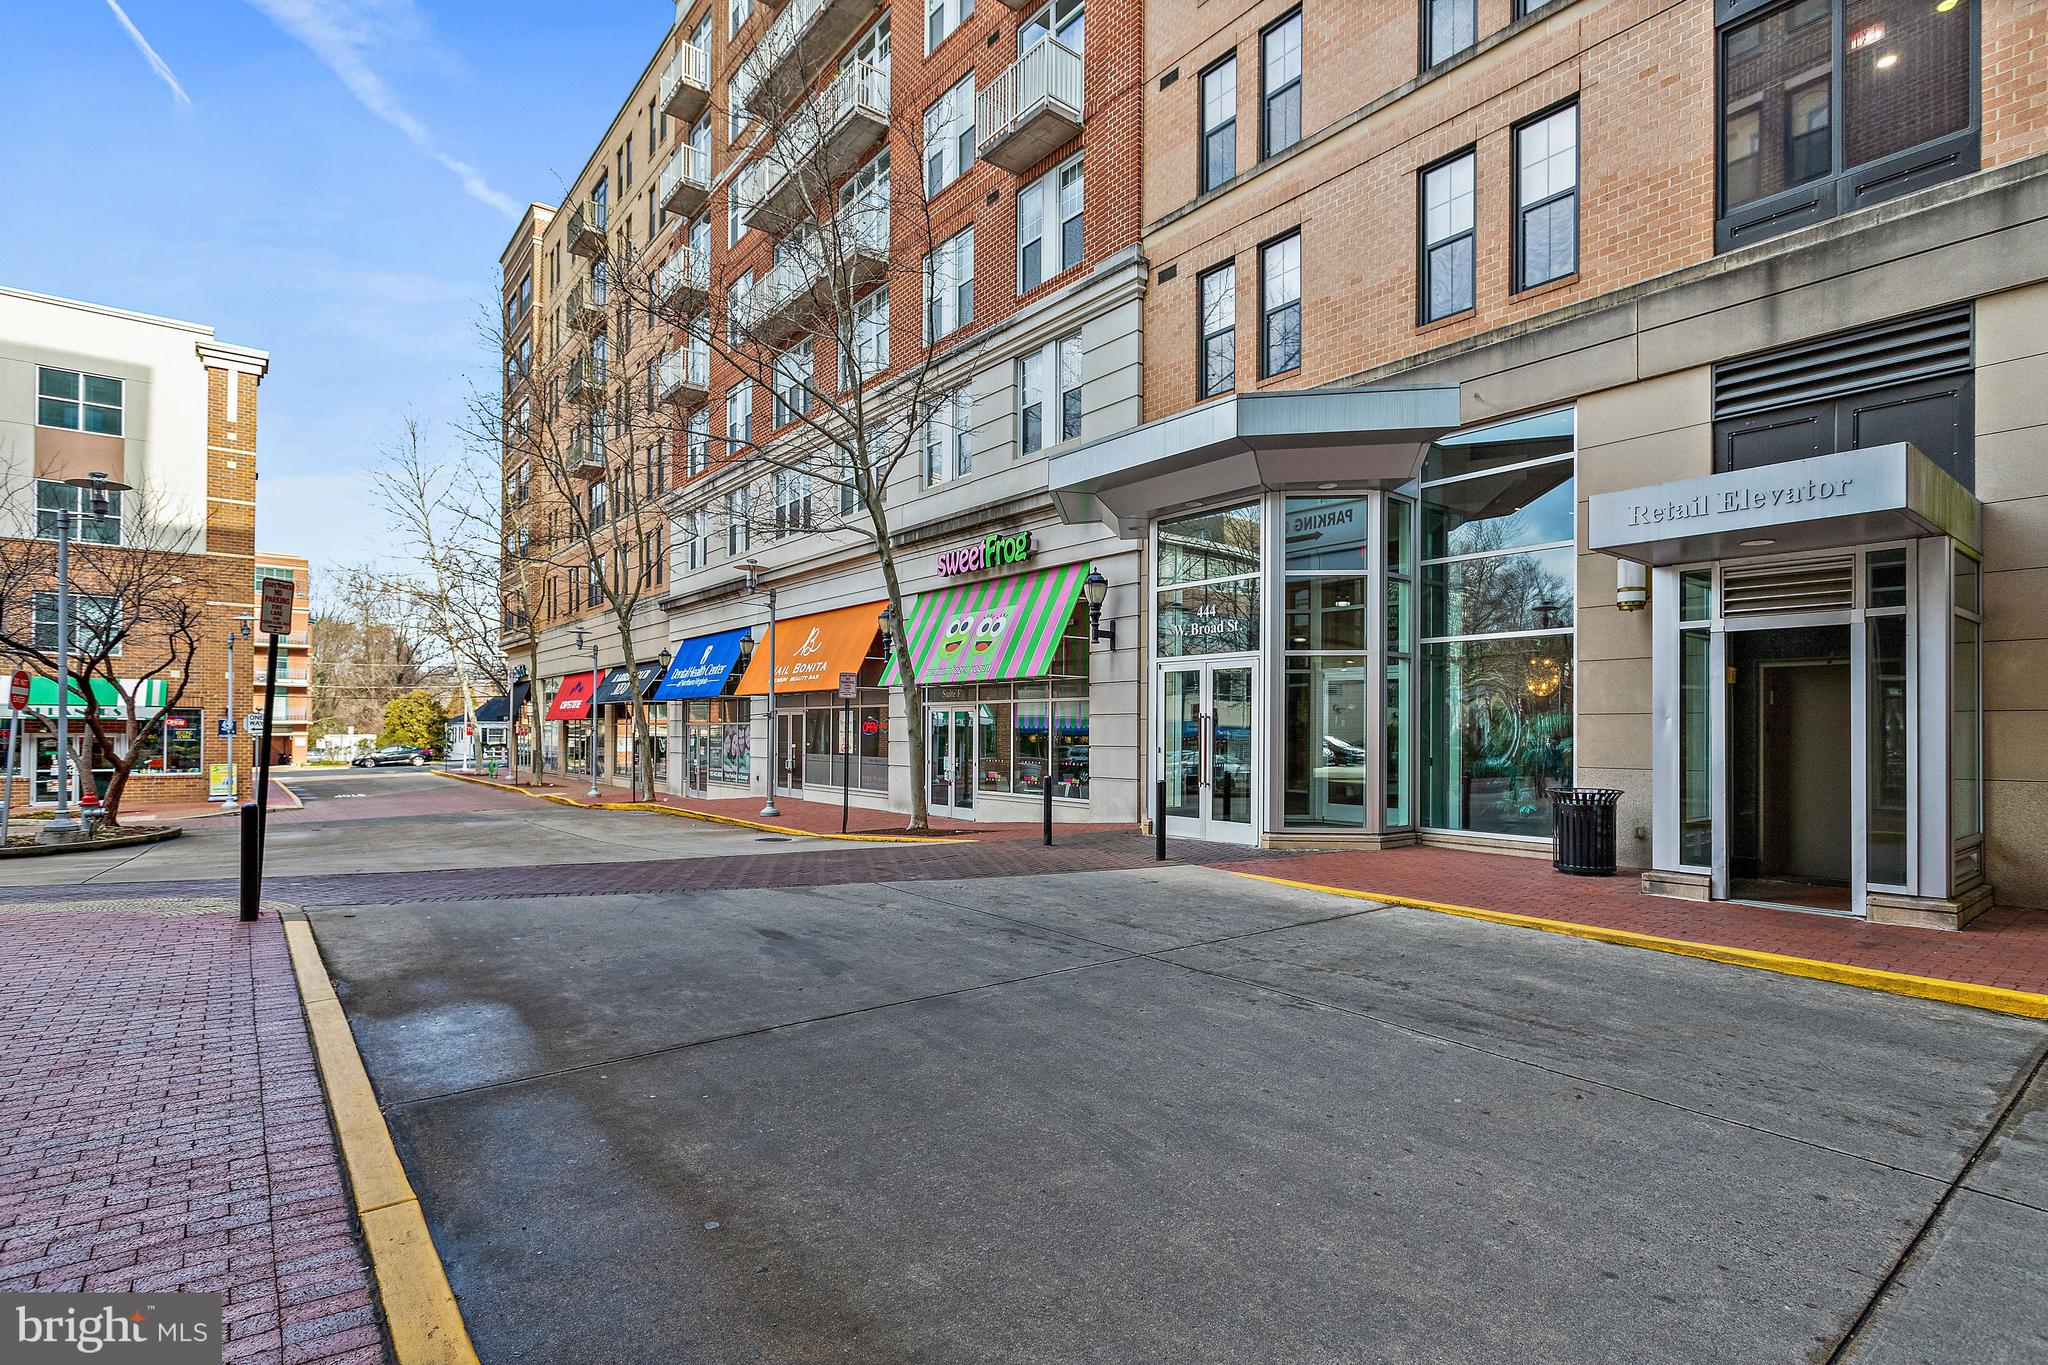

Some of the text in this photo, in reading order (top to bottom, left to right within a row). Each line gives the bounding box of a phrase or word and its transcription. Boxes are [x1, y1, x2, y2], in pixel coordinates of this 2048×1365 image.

[1628, 478, 1853, 526] Retail Elevator
[937, 531, 1030, 577] sweetFrog
[265, 595, 290, 605] PARKING
[1197, 604, 1217, 618] 444
[1174, 619, 1243, 637] W. Broad St.
[705, 664, 727, 676] Center
[792, 661, 828, 674] BONITA
[942, 689, 956, 698] Suite
[863, 721, 878, 733] OPEN
